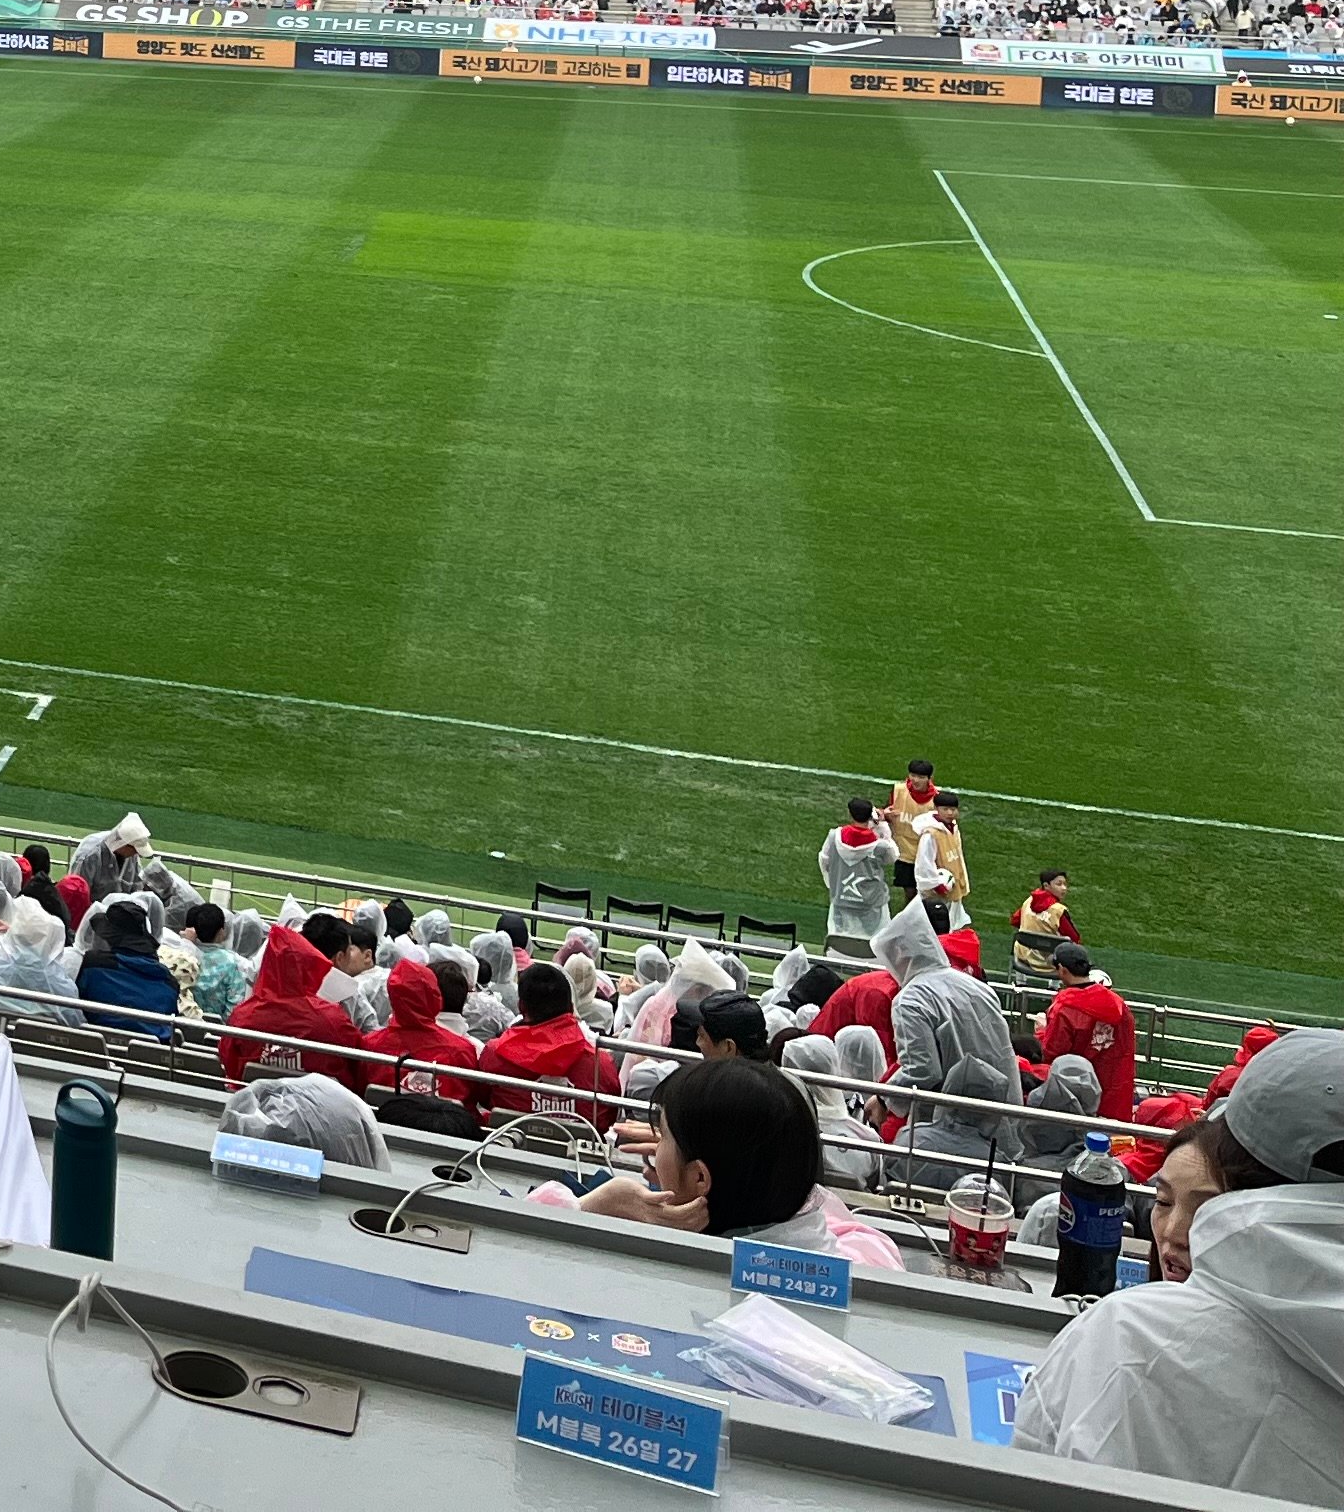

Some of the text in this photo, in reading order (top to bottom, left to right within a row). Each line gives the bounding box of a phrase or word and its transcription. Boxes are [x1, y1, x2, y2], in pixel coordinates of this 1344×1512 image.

[75, 4, 249, 27] GS SHOP
[276, 15, 474, 36] GS THE FRESH
[528, 25, 709, 48] NH투자증권
[314, 48, 388, 67] 국대급 한돈
[452, 55, 481, 71] 국산
[562, 61, 622, 77] 고집하는
[1018, 48, 1185, 69] FC서울 아카데미
[667, 66, 744, 84] 입단하시죠
[1064, 84, 1153, 106] 국대급 한돈
[1231, 92, 1265, 108] 국산
[531, 1091, 576, 1113] Seoul
[777, 1258, 830, 1278] 테이블석
[741, 1269, 838, 1299] M블록 24열 27
[554, 1386, 688, 1438] KRUSH 테이블석
[536, 1411, 698, 1474] M블록 26열 27
